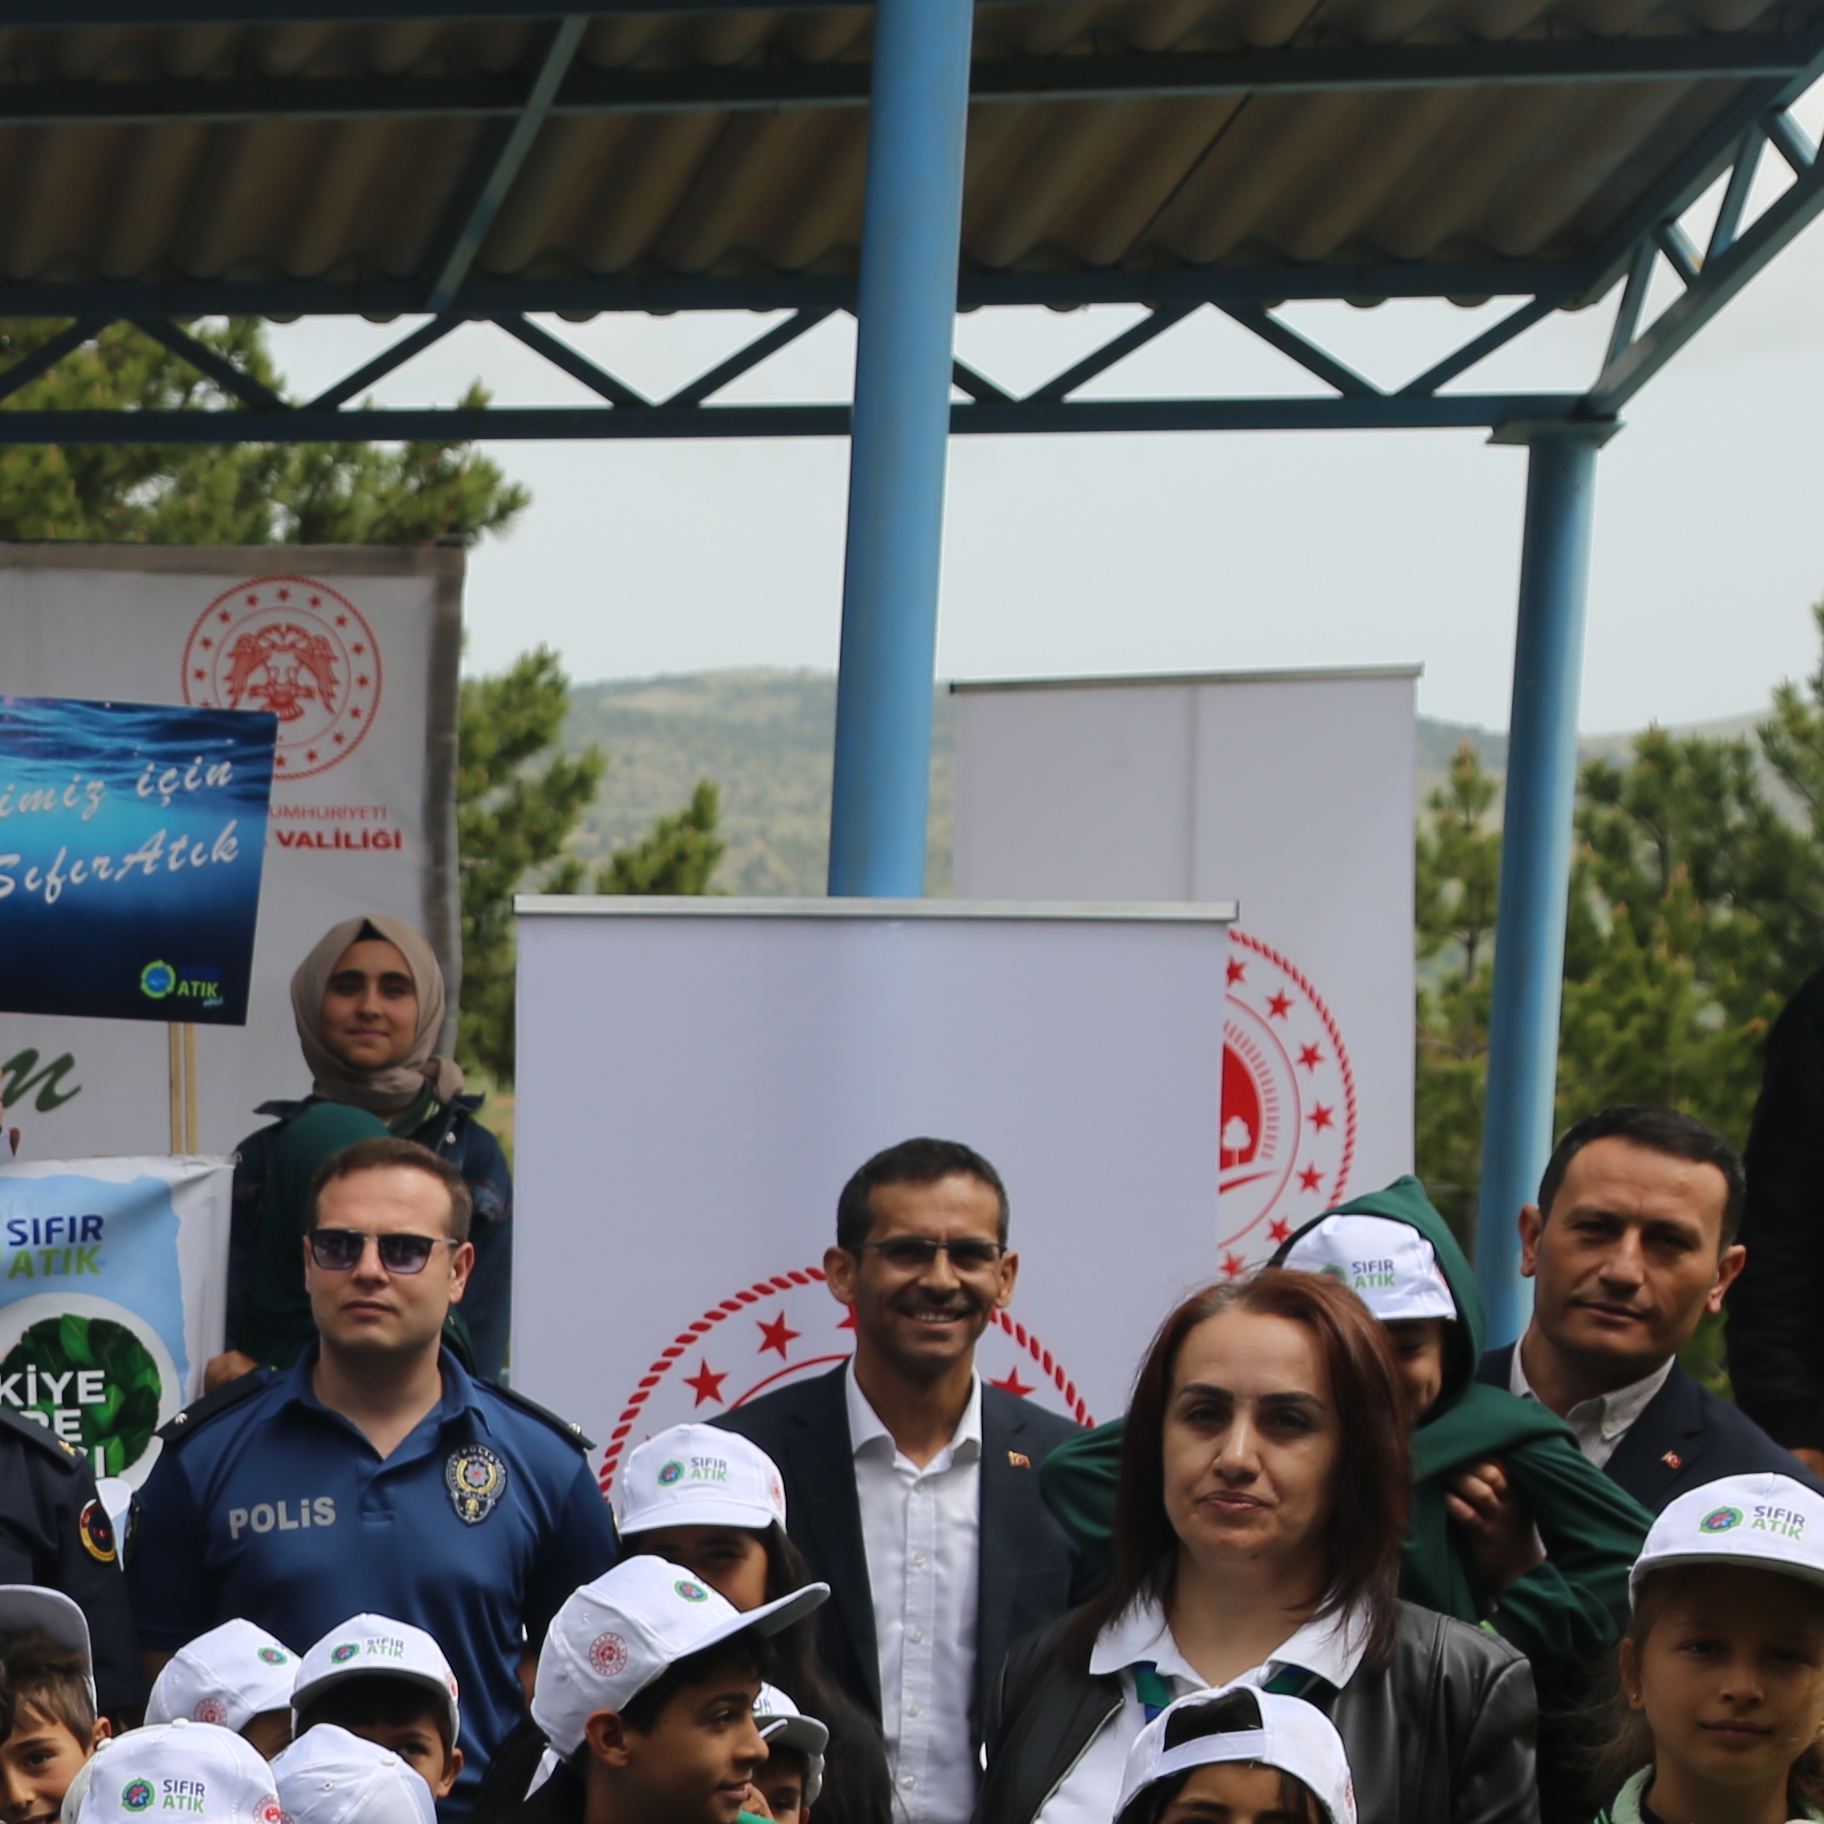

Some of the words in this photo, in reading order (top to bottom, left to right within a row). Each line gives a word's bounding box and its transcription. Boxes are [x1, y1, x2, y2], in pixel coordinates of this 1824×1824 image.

[135, 755, 233, 808] için
[276, 826, 401, 850] VALİLİĞİ
[177, 981, 219, 997] ATIK
[5, 1214, 104, 1246] SIFIR
[8, 1244, 102, 1279] ATIK
[1353, 1260, 1393, 1274] SIFIR
[1355, 1271, 1394, 1288] ATIK
[690, 1456, 726, 1470] SIFIR
[690, 1466, 726, 1481] ATIK
[1754, 1505, 1806, 1527] SIFIR
[1753, 1517, 1802, 1540] ATIK
[163, 1780, 206, 1796] SIFIR
[164, 1795, 204, 1812] ATIK
